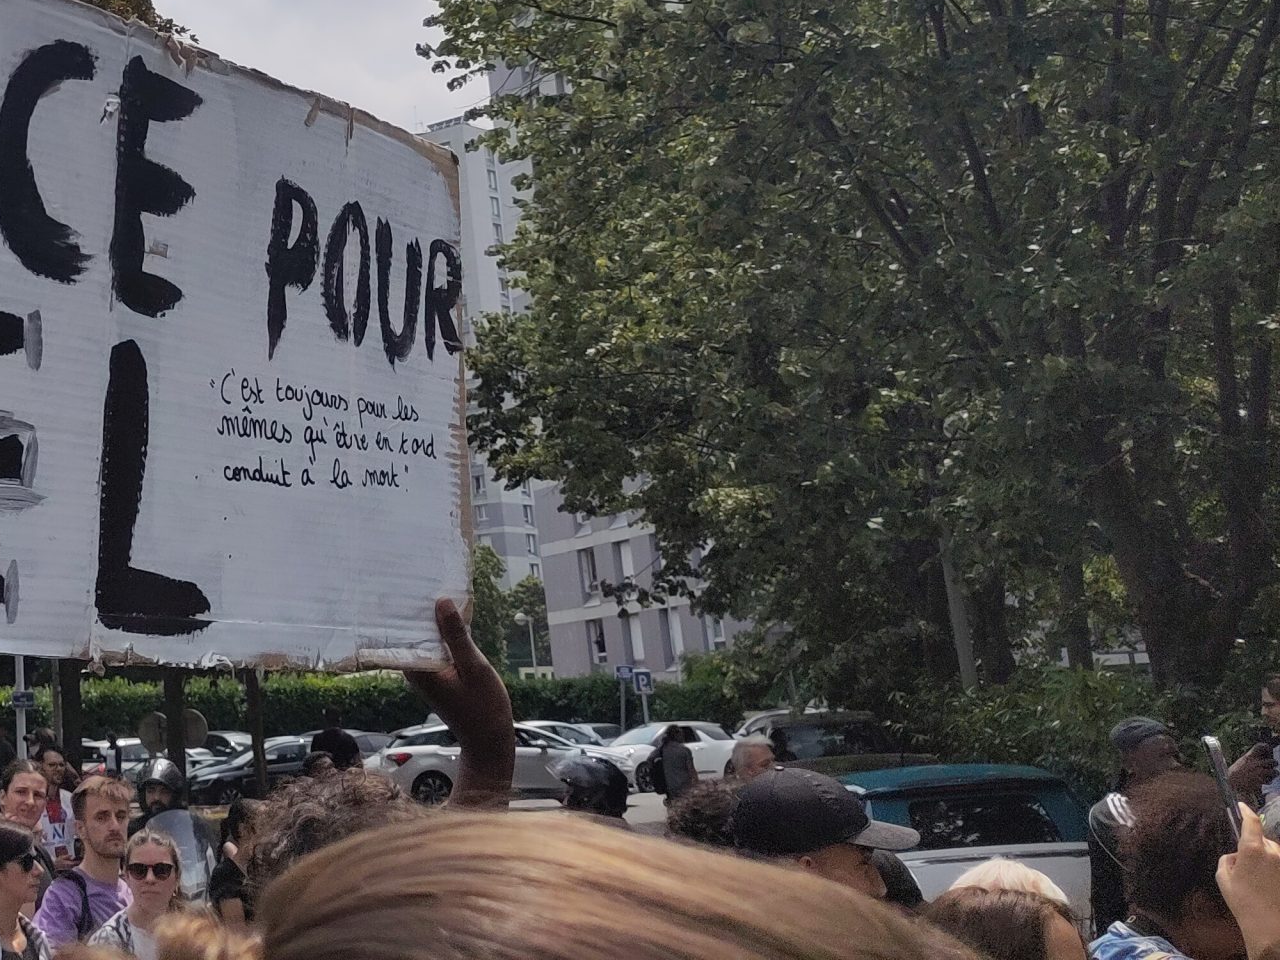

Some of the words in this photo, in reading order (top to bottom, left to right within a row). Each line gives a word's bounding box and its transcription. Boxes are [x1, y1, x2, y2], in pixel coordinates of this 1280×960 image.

[265, 175, 464, 372] POUR
[276, 377, 348, 421] toujours
[357, 397, 387, 428] pour
[392, 395, 419, 422] les
[217, 405, 292, 444] mêmes
[376, 431, 394, 452] en
[223, 456, 292, 488] conduit
[330, 458, 353, 489] la
